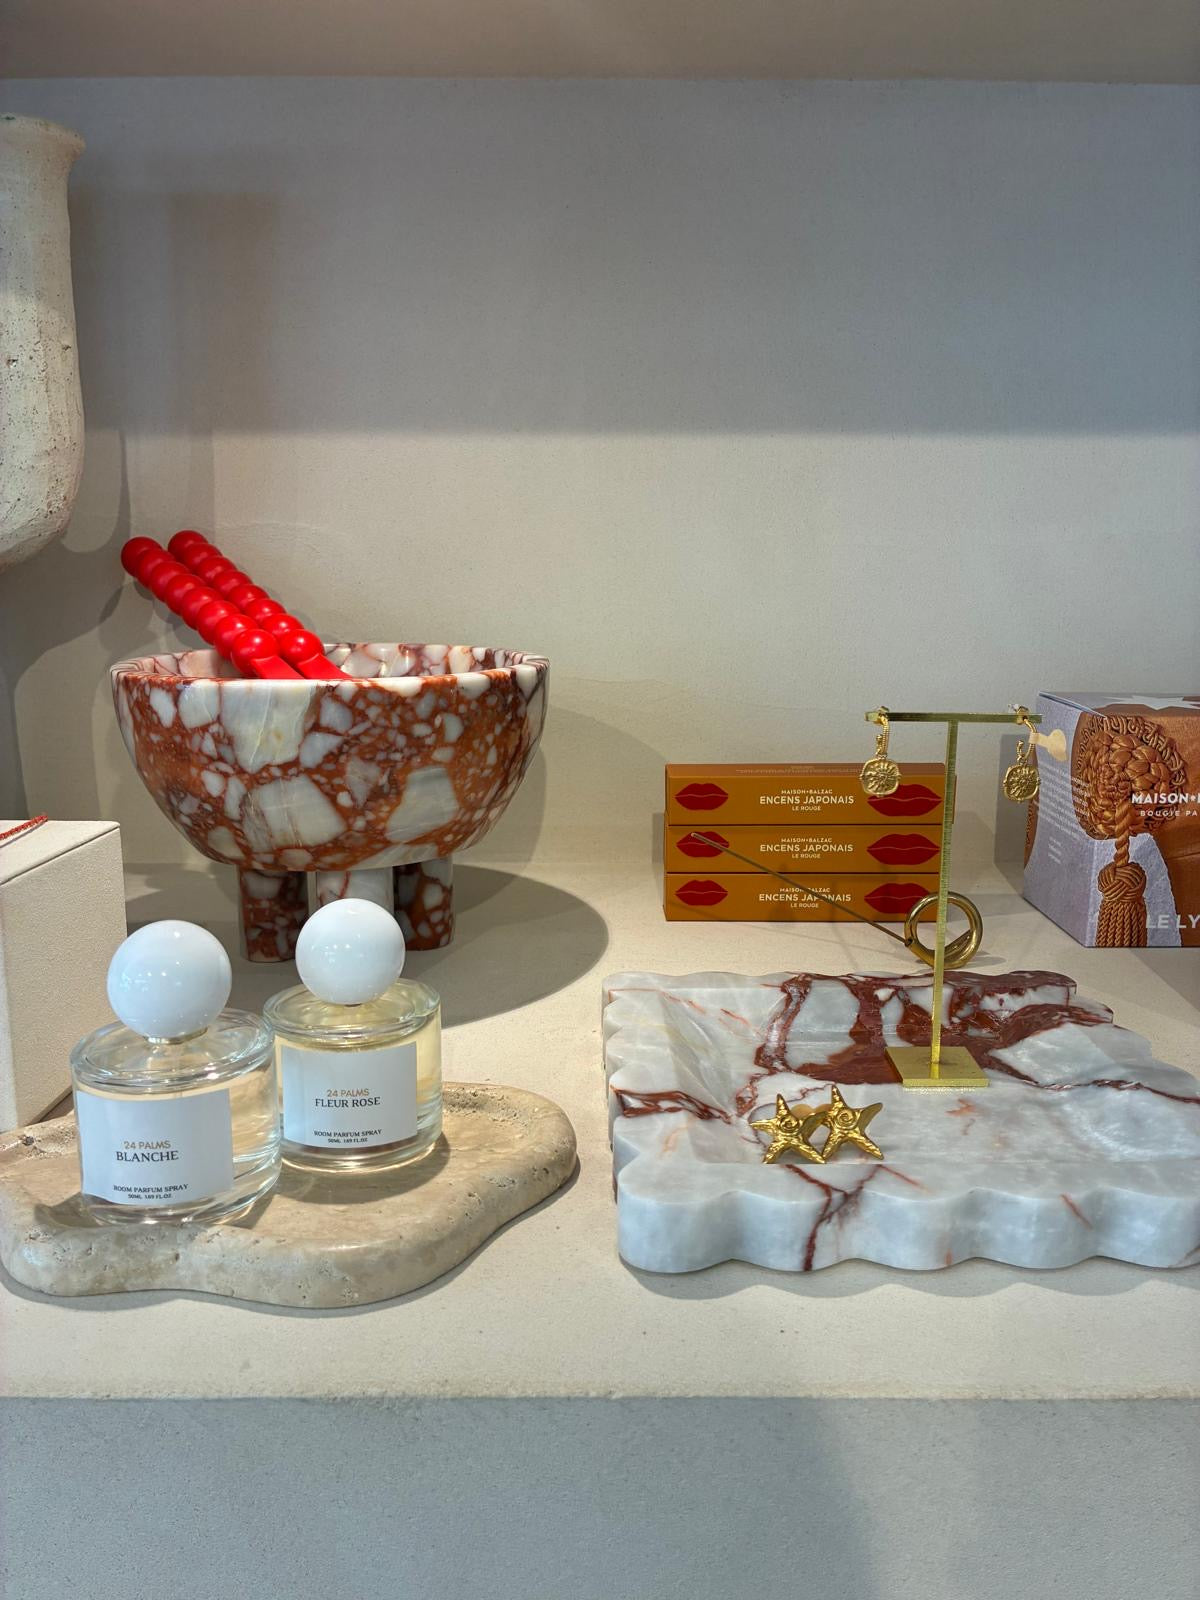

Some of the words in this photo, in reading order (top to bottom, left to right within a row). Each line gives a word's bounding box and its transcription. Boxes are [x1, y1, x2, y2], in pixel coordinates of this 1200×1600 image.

[759, 795, 801, 805] ENCENS
[803, 795, 854, 805] JAPONAIS
[760, 844, 800, 852] ENCENS
[803, 844, 854, 852] JAPONAIS
[758, 893, 799, 902] ENCENS
[1145, 914, 1170, 929] LE
[326, 1089, 338, 1097] 24
[340, 1088, 370, 1097] PALMS
[314, 1098, 349, 1108] FLEUR
[352, 1097, 381, 1108] ROSE
[124, 1140, 136, 1149] 24
[138, 1140, 171, 1149] PALMS
[116, 1150, 179, 1162] BLANCHE
[113, 1184, 133, 1192] ROOM
[164, 1183, 189, 1192] SPRAY
